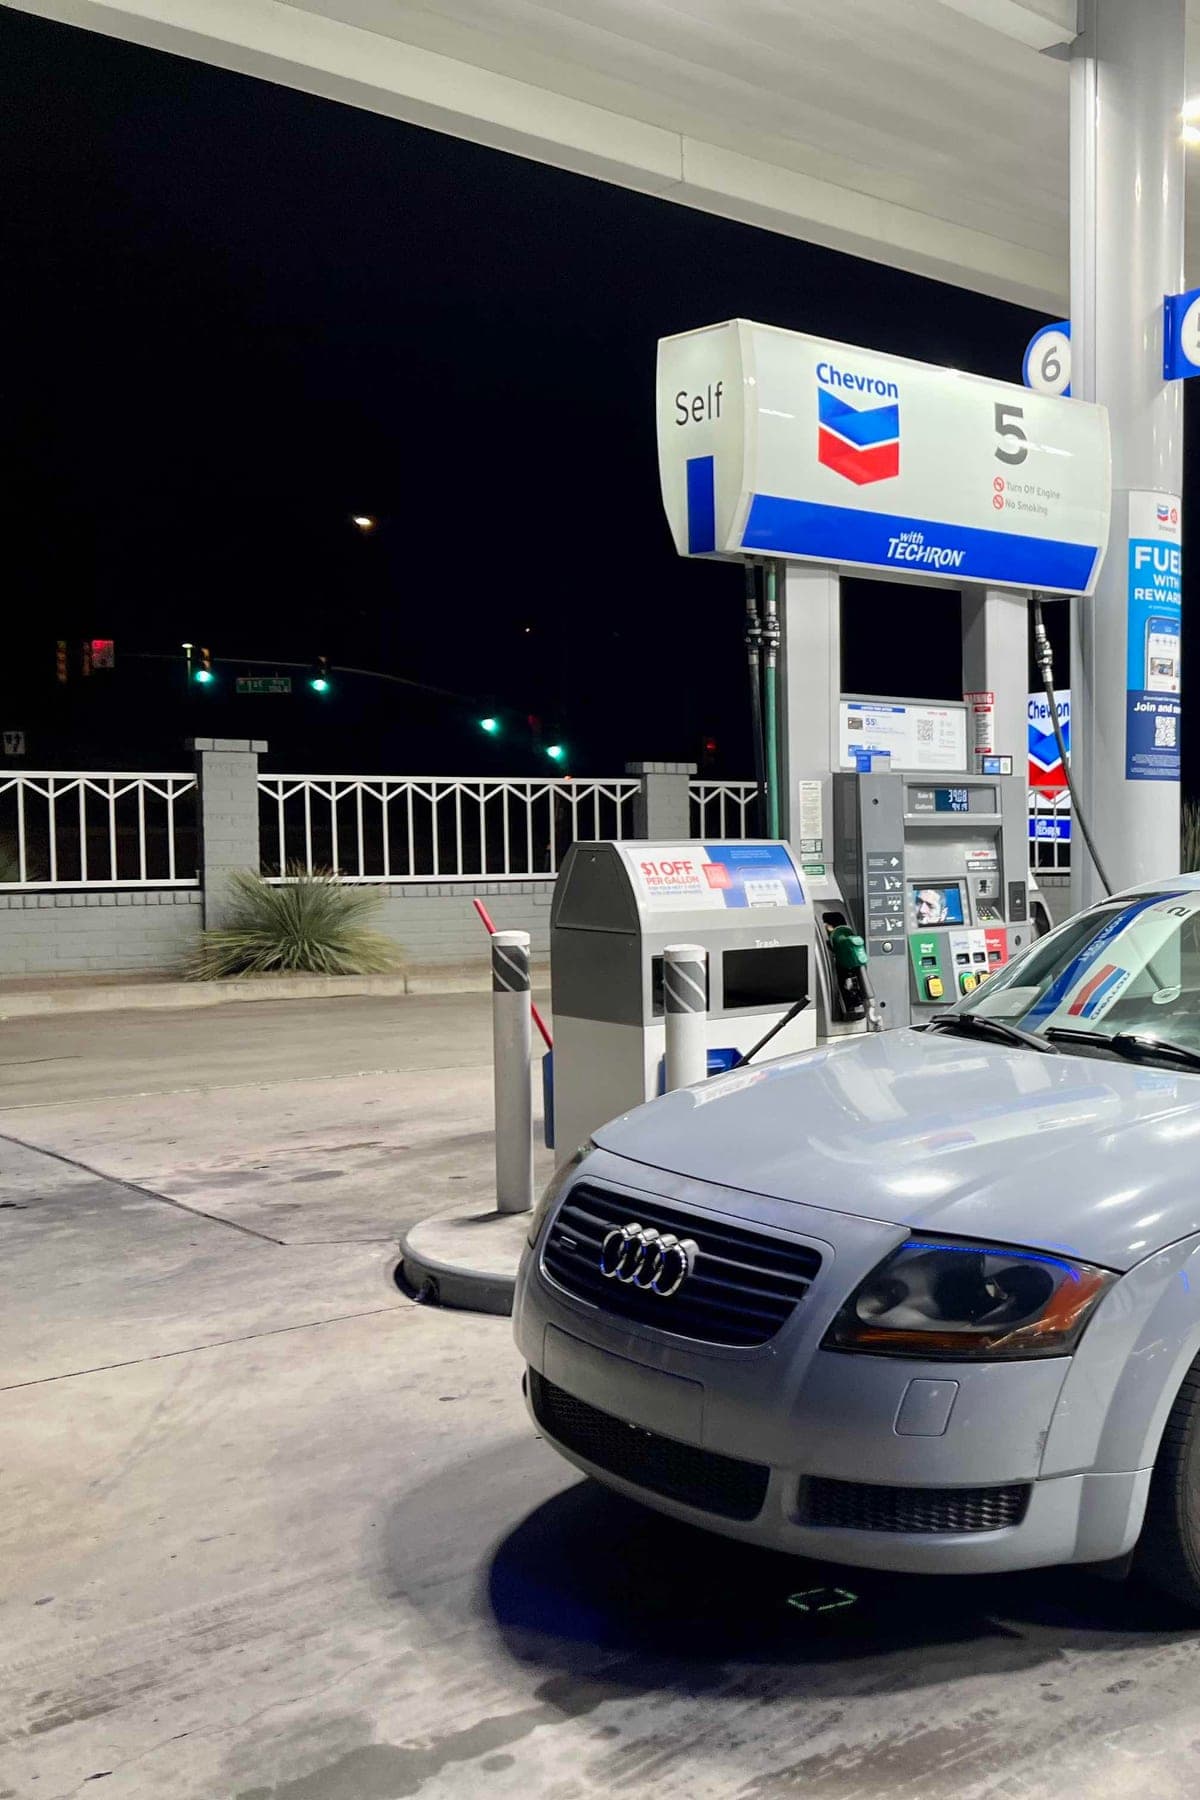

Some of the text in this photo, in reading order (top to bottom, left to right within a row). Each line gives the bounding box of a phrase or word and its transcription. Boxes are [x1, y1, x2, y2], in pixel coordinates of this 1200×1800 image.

[1041, 346, 1061, 382] 6
[815, 361, 899, 399] Chevron
[674, 380, 723, 426] Self
[994, 402, 1028, 465] 5
[1007, 481, 1022, 493] Turn
[1036, 487, 1060, 500] Engine
[1006, 499, 1048, 516] No Smoking
[900, 531, 924, 545] with
[887, 537, 964, 569] TECHRON
[1027, 700, 1070, 720] Chevon
[1133, 702, 1157, 712] Join
[640, 860, 694, 876] $1 OFF
